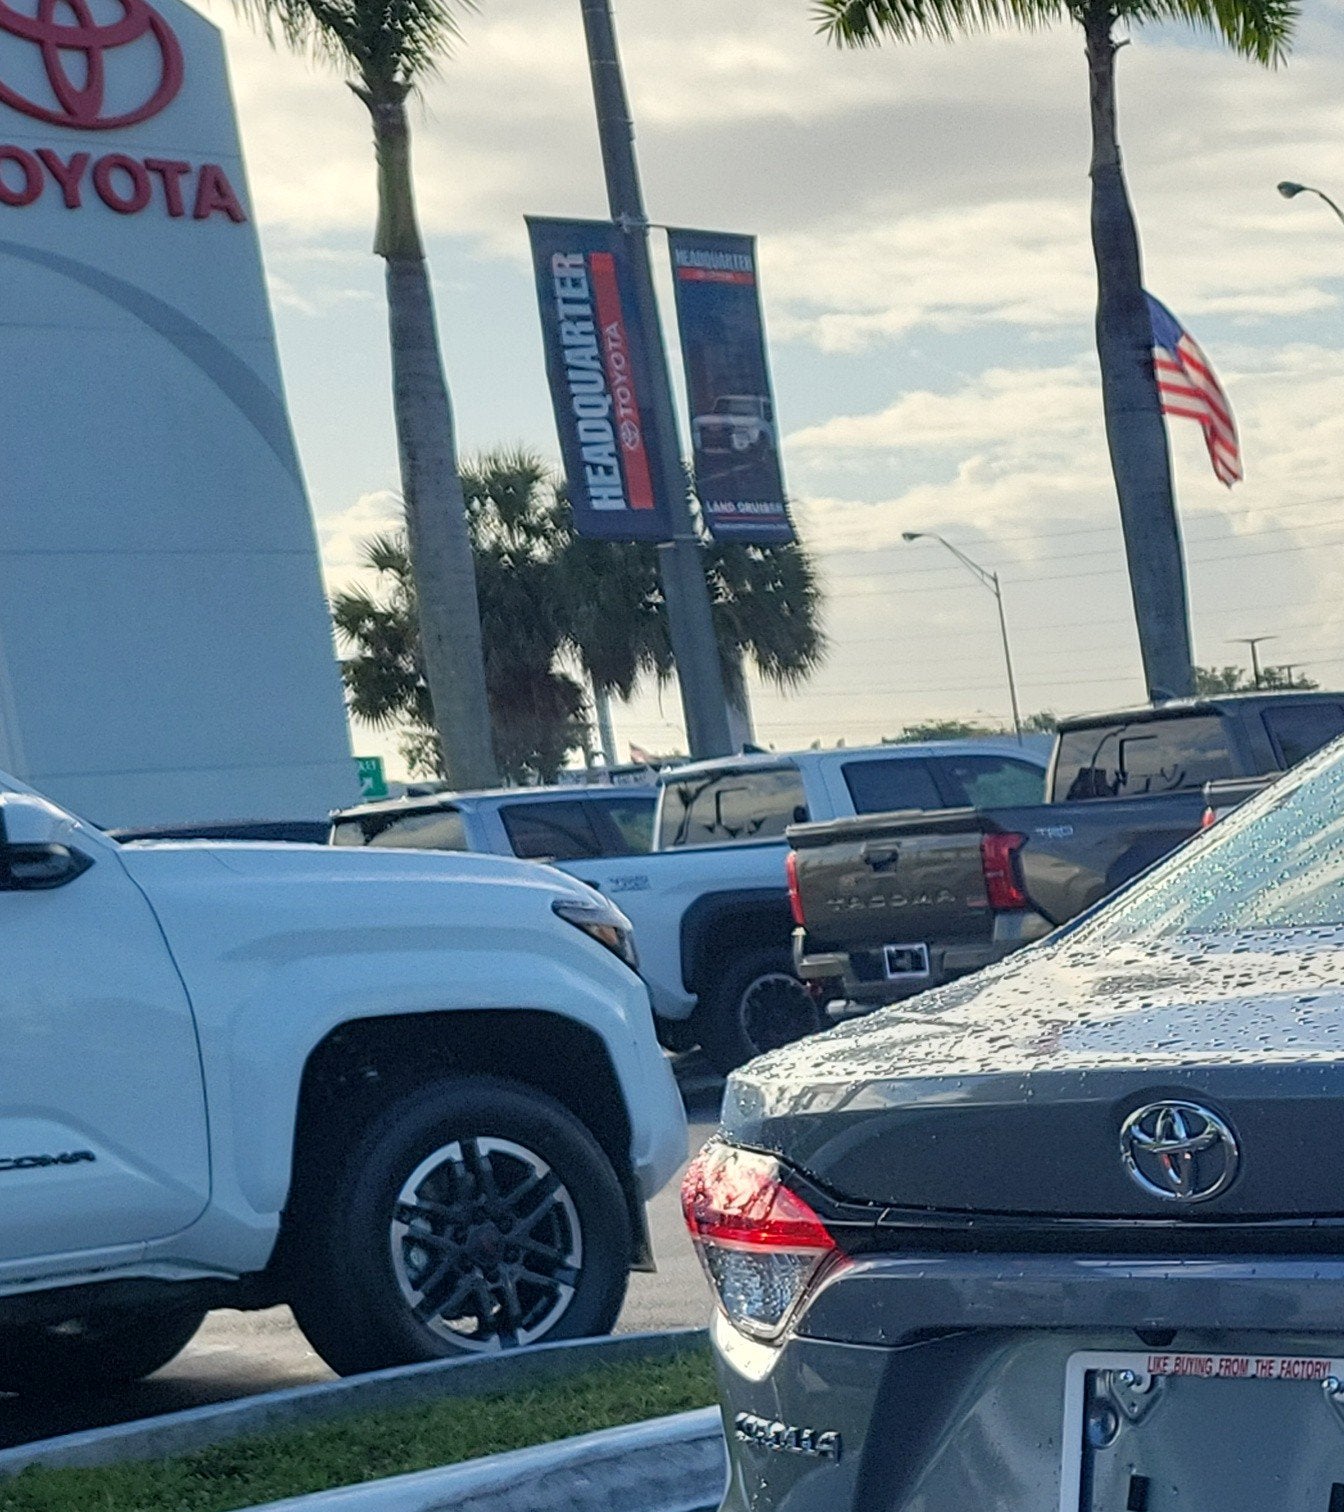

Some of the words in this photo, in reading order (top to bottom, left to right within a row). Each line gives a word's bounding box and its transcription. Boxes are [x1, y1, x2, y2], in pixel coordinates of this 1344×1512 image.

[0, 144, 248, 223] OYOTA
[552, 252, 627, 511] HEADQUARTER
[604, 320, 635, 418] TOYOTA
[1147, 1356, 1169, 1374] LIKE
[1174, 1357, 1213, 1376] BUYING
[1218, 1358, 1250, 1377] FROM
[1255, 1359, 1275, 1377] THE
